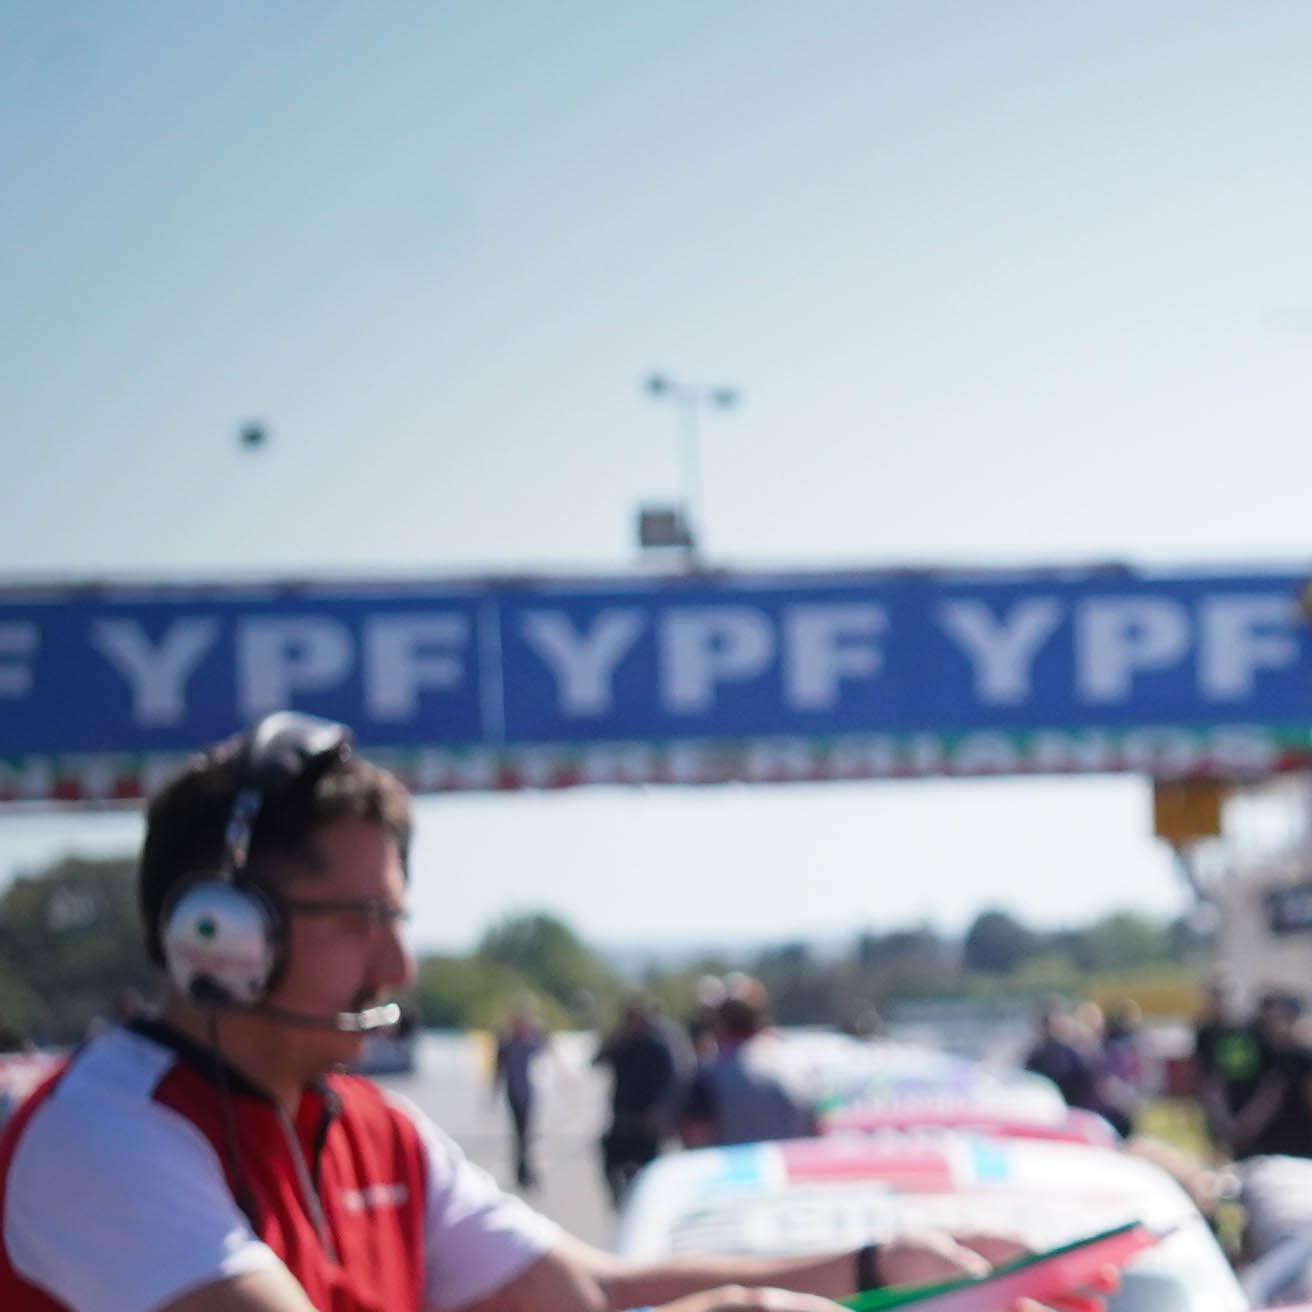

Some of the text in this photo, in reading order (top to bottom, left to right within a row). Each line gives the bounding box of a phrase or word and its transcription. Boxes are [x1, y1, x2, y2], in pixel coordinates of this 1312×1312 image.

[94, 612, 470, 722] YPF
[520, 603, 888, 715] YPF
[938, 592, 1300, 706] YPF
